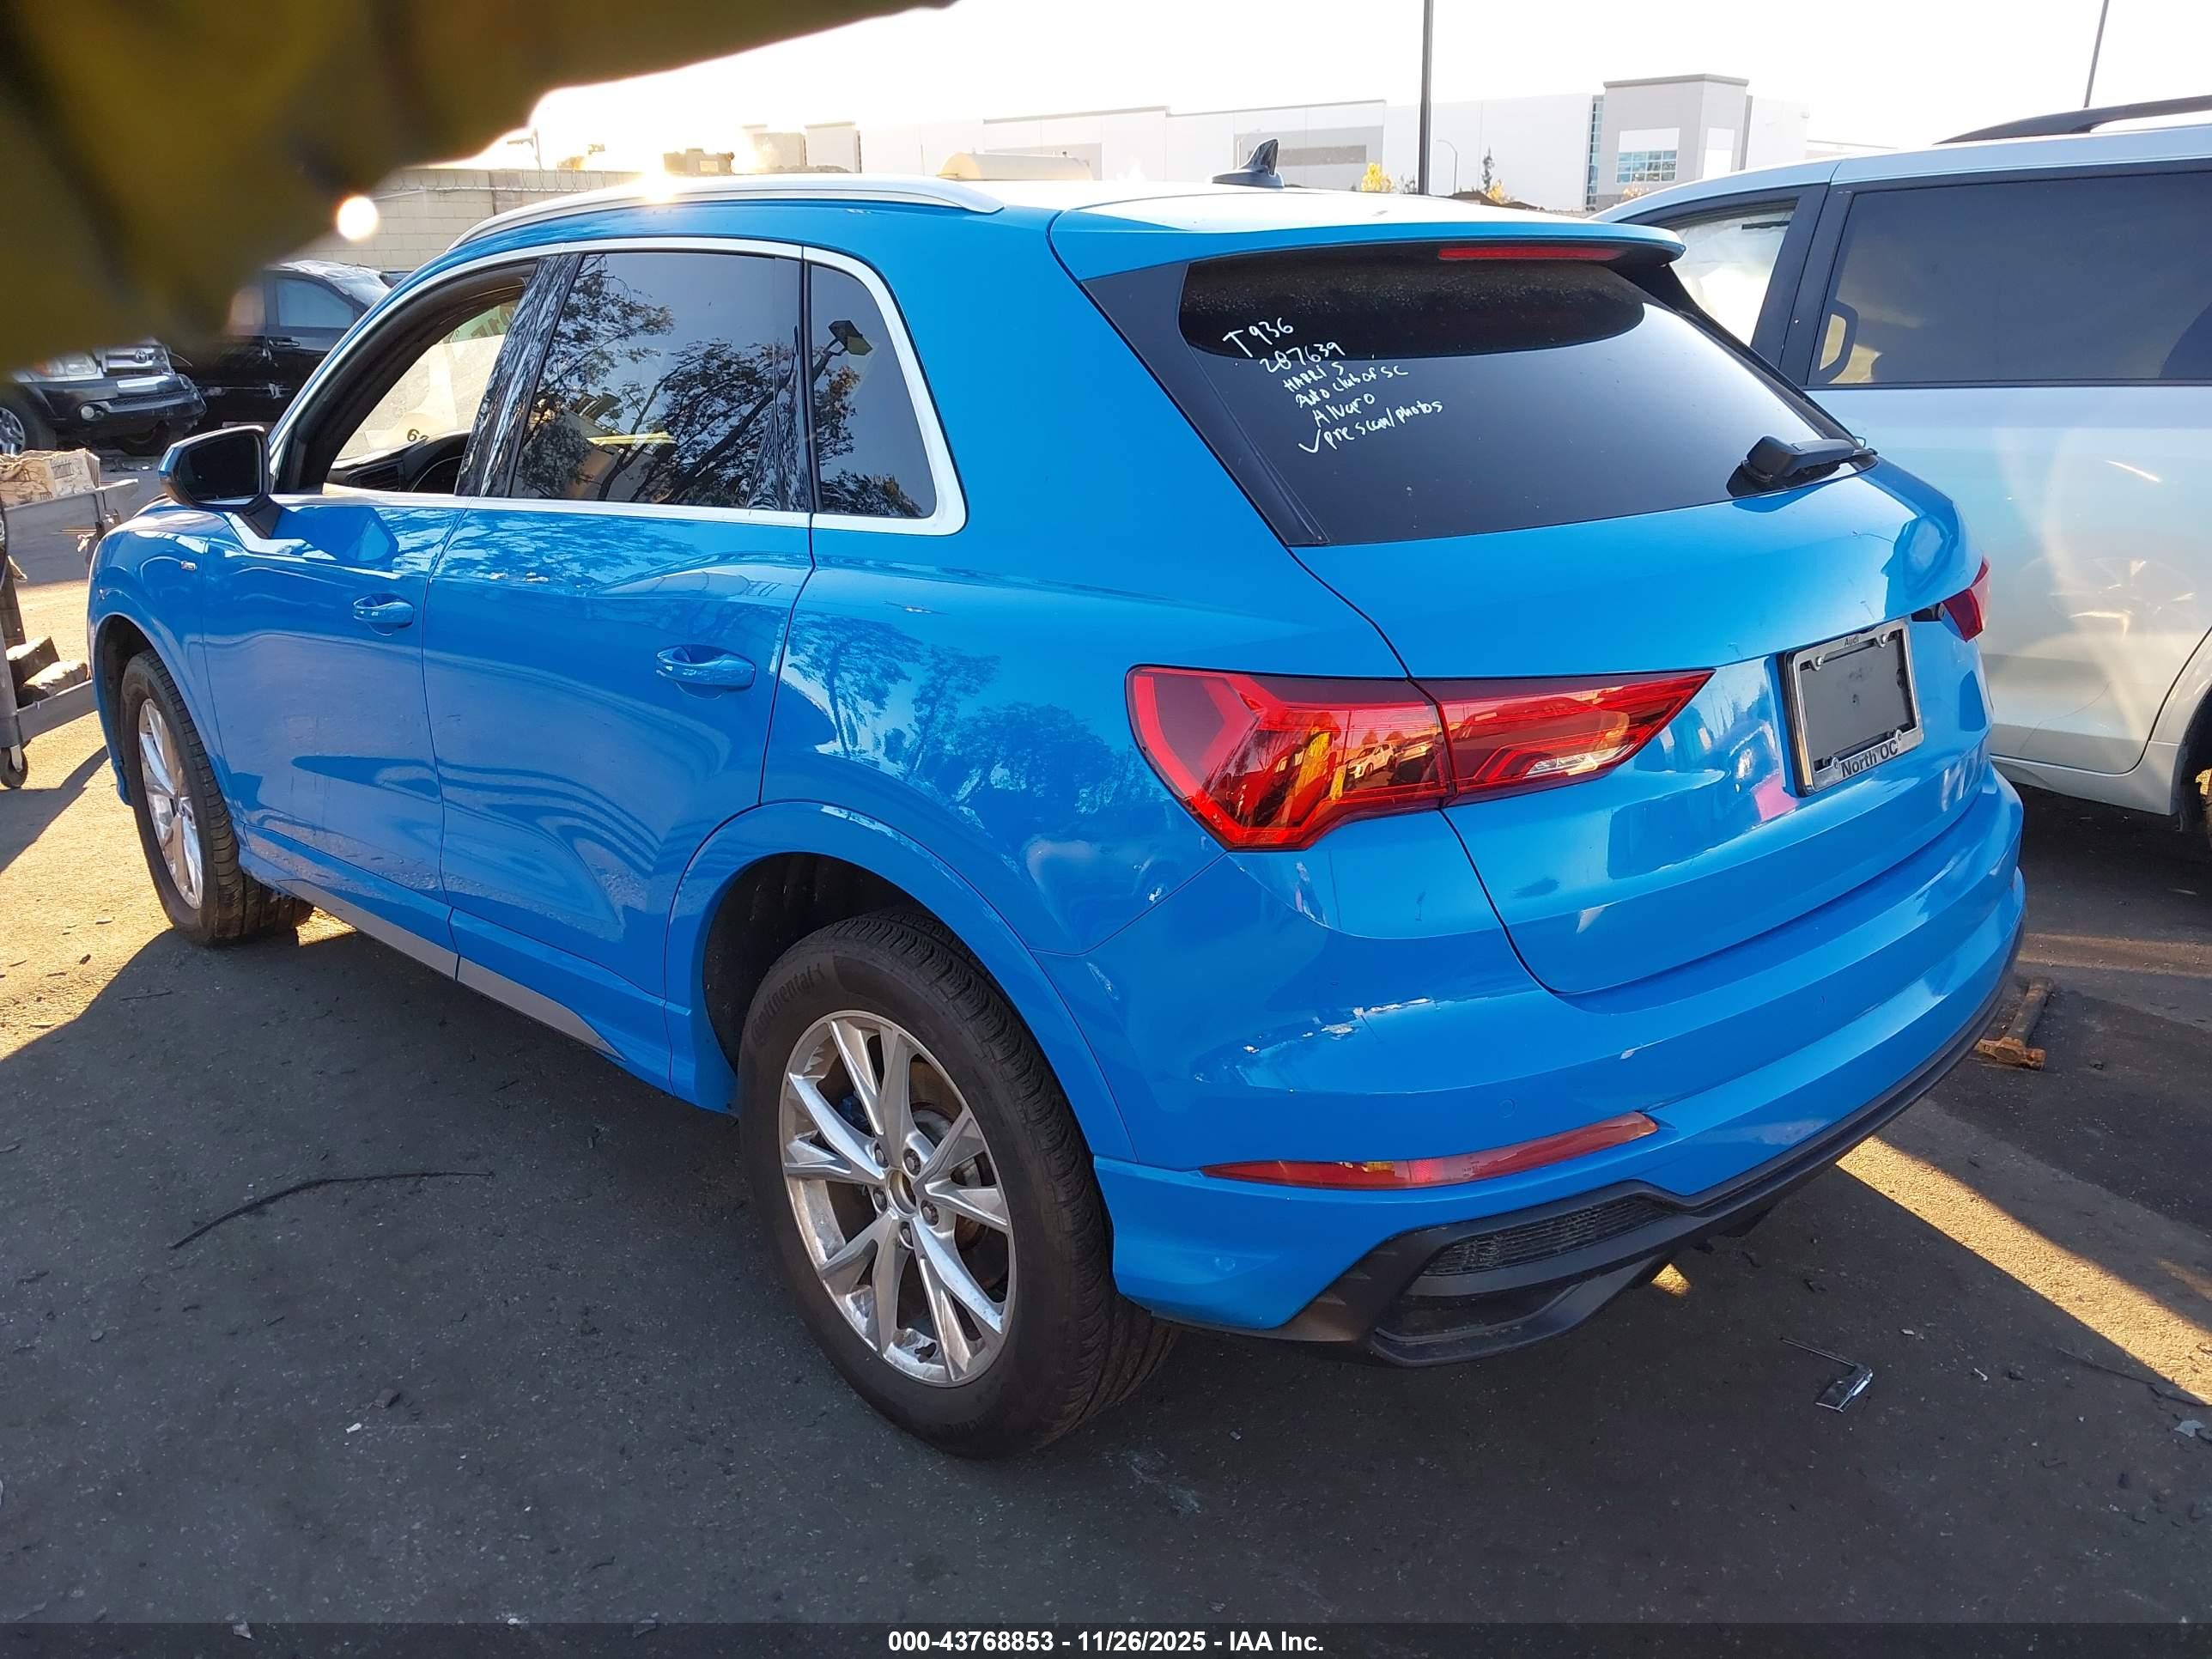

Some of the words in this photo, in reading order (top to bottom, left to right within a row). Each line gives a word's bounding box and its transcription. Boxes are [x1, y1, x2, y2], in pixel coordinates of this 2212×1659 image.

[1844, 635, 1859, 647] Audi
[1840, 752, 1877, 778] North
[1880, 739, 1899, 760] OC
